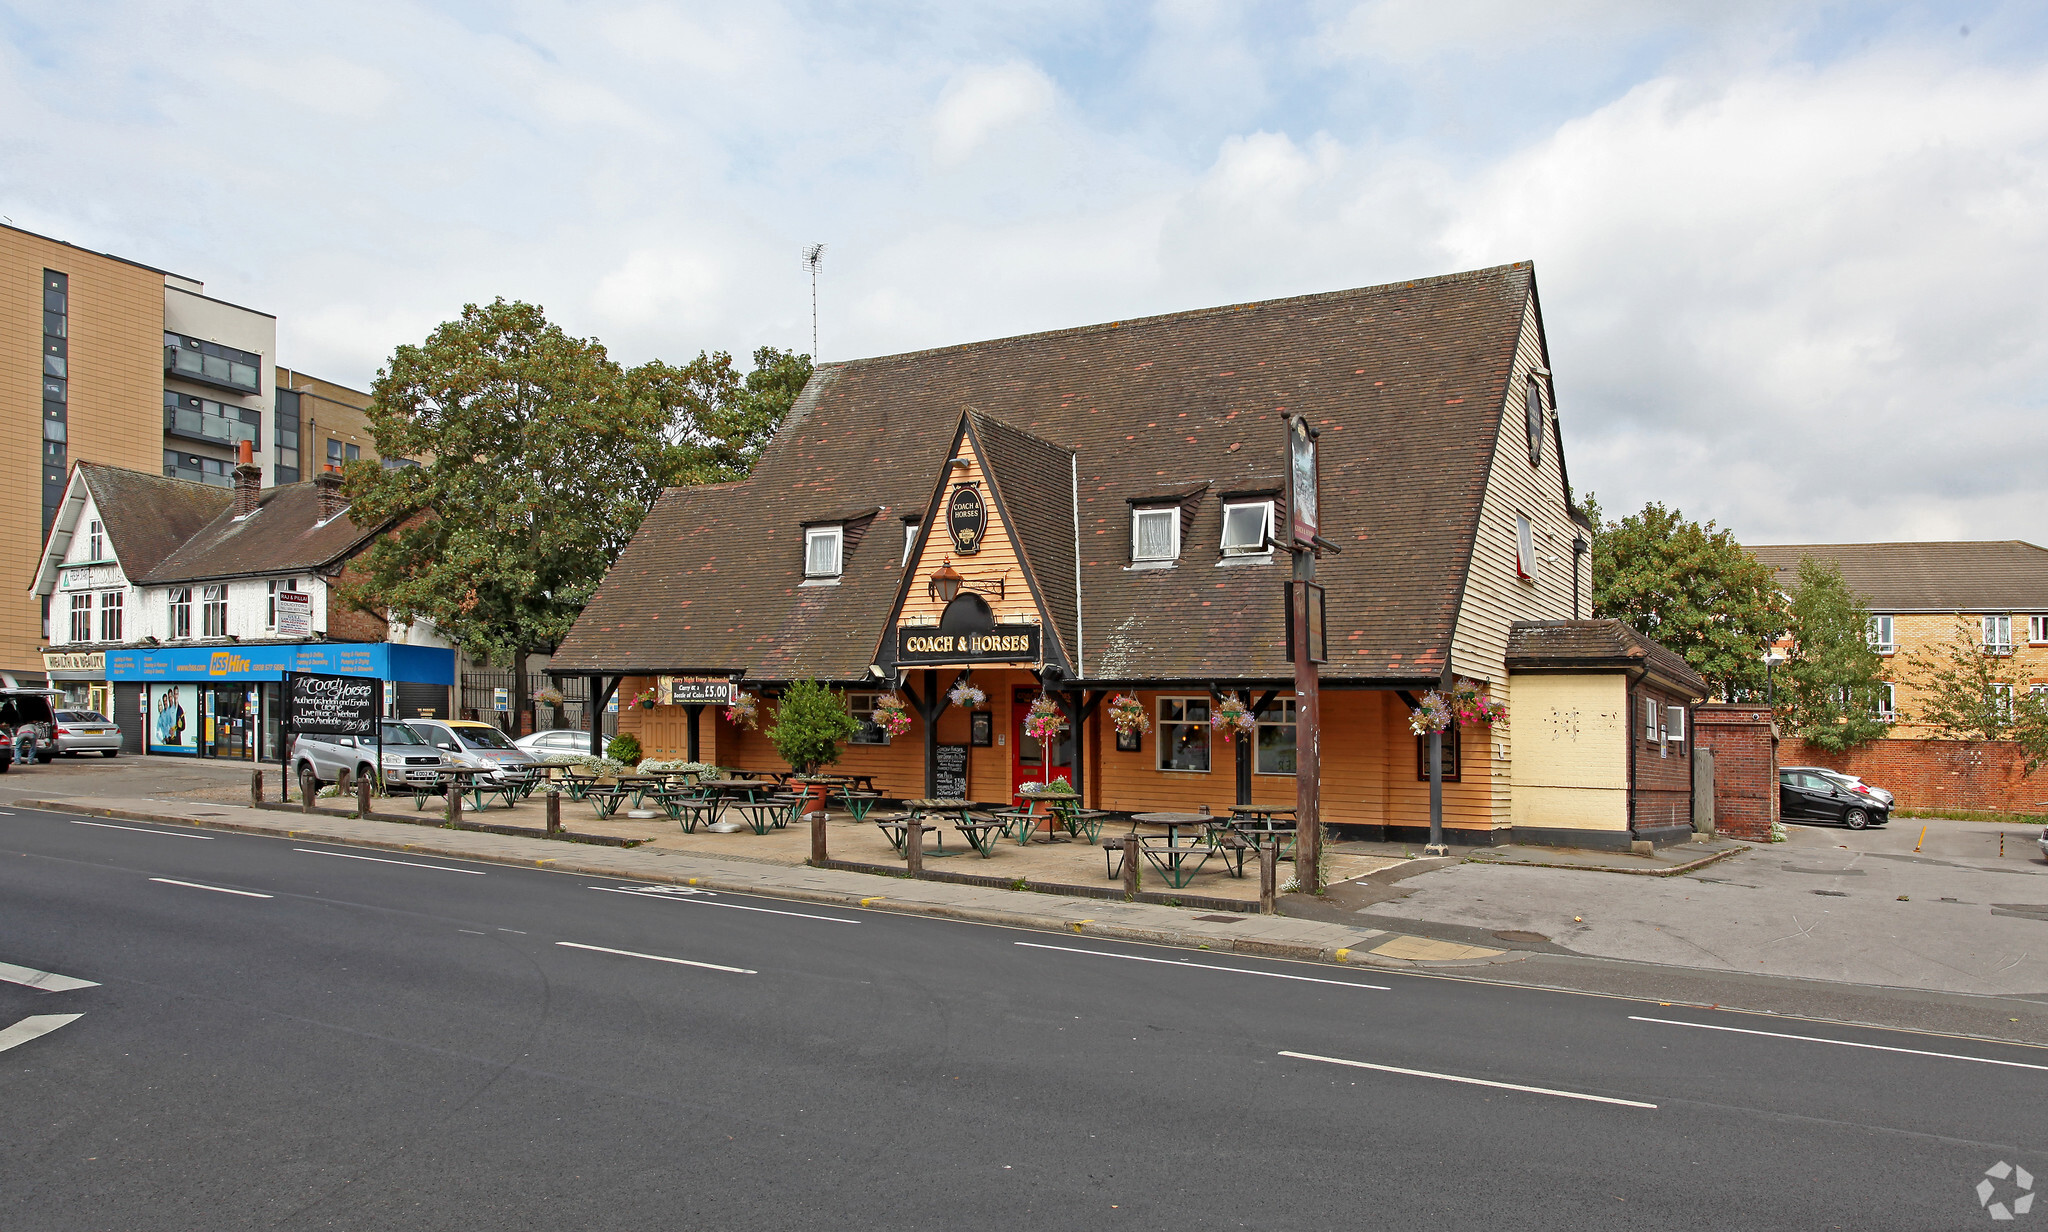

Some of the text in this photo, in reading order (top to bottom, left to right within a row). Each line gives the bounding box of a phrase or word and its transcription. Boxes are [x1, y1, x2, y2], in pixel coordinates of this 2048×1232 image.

[954, 502, 974, 510] COACH
[954, 510, 978, 519] HORSES
[906, 634, 1029, 652] COACH & HORSES
[228, 655, 251, 672] Hire
[306, 678, 342, 695] Coach
[704, 685, 727, 698] £5.00
